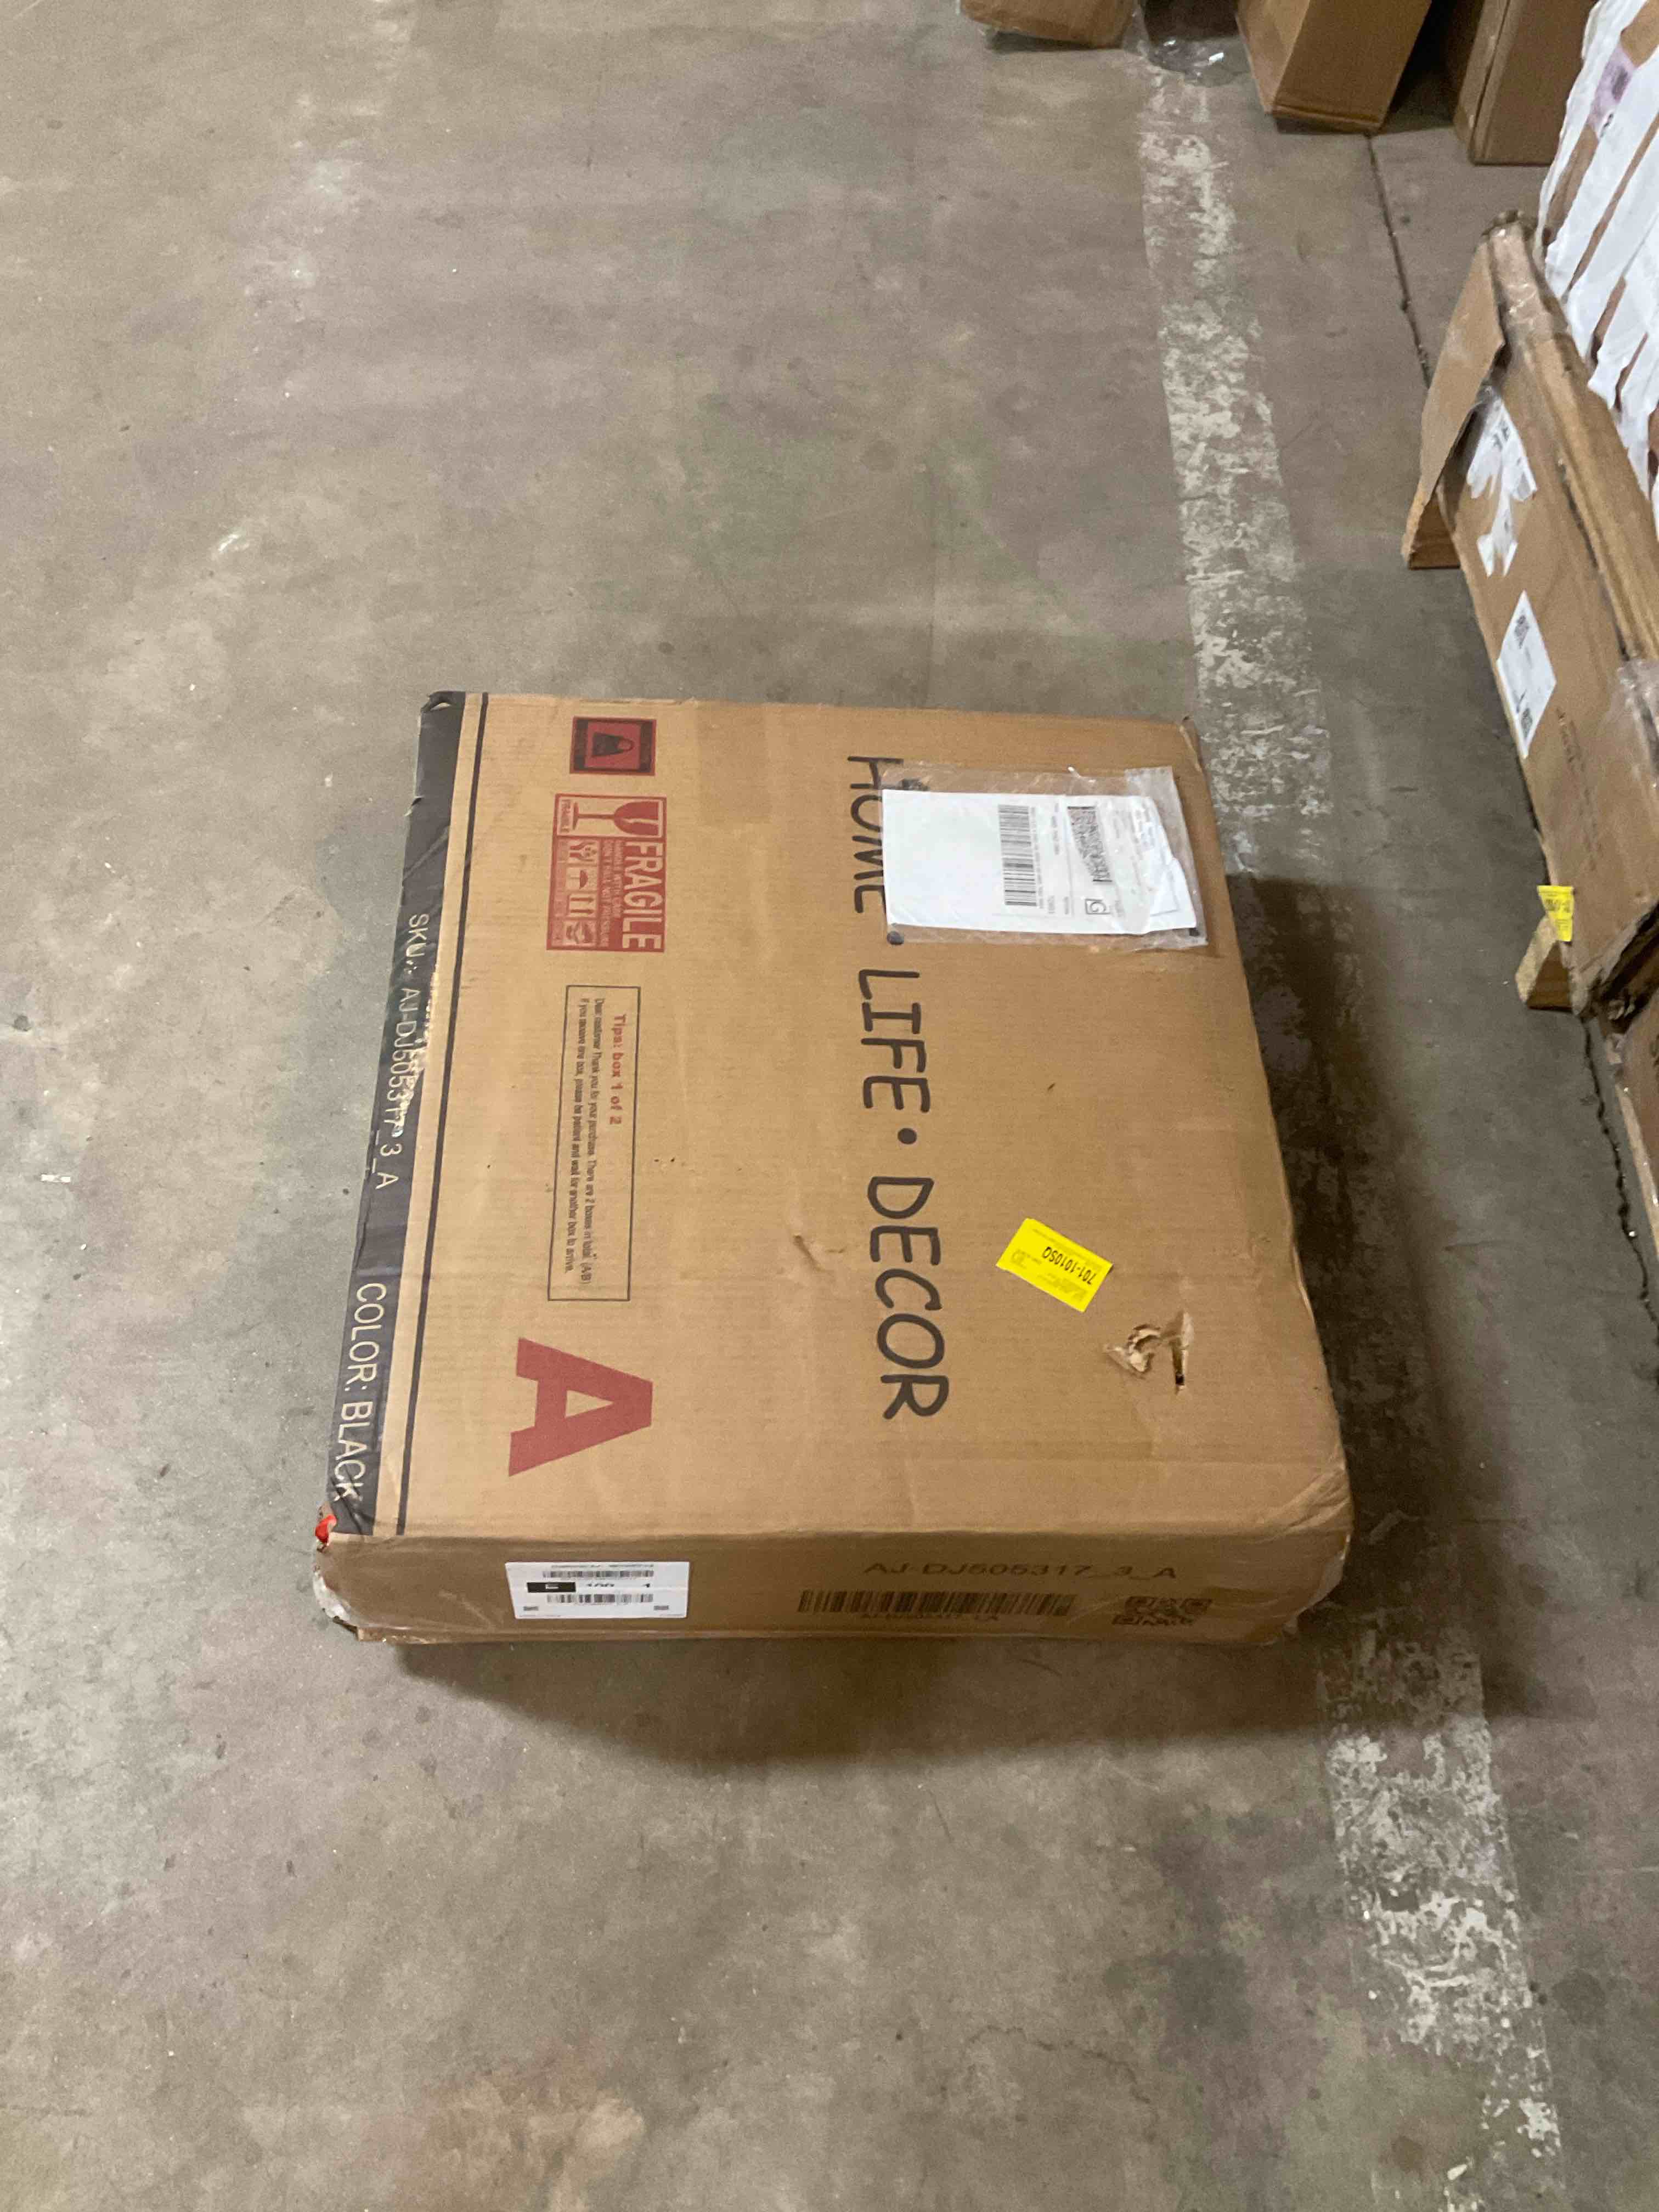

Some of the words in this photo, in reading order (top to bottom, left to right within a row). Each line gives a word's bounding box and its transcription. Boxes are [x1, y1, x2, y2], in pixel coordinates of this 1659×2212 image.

[622, 841, 663, 949] FRAGILE
[612, 1053, 624, 1078] box
[857, 968, 930, 1113] LIFE
[610, 1096, 623, 1110] of
[610, 1115, 622, 1125] 2
[345, 1282, 386, 1391] COLOR:
[866, 1176, 949, 1420] DECOR
[334, 1401, 373, 1502] BLACK
[508, 1336, 653, 1477] A
